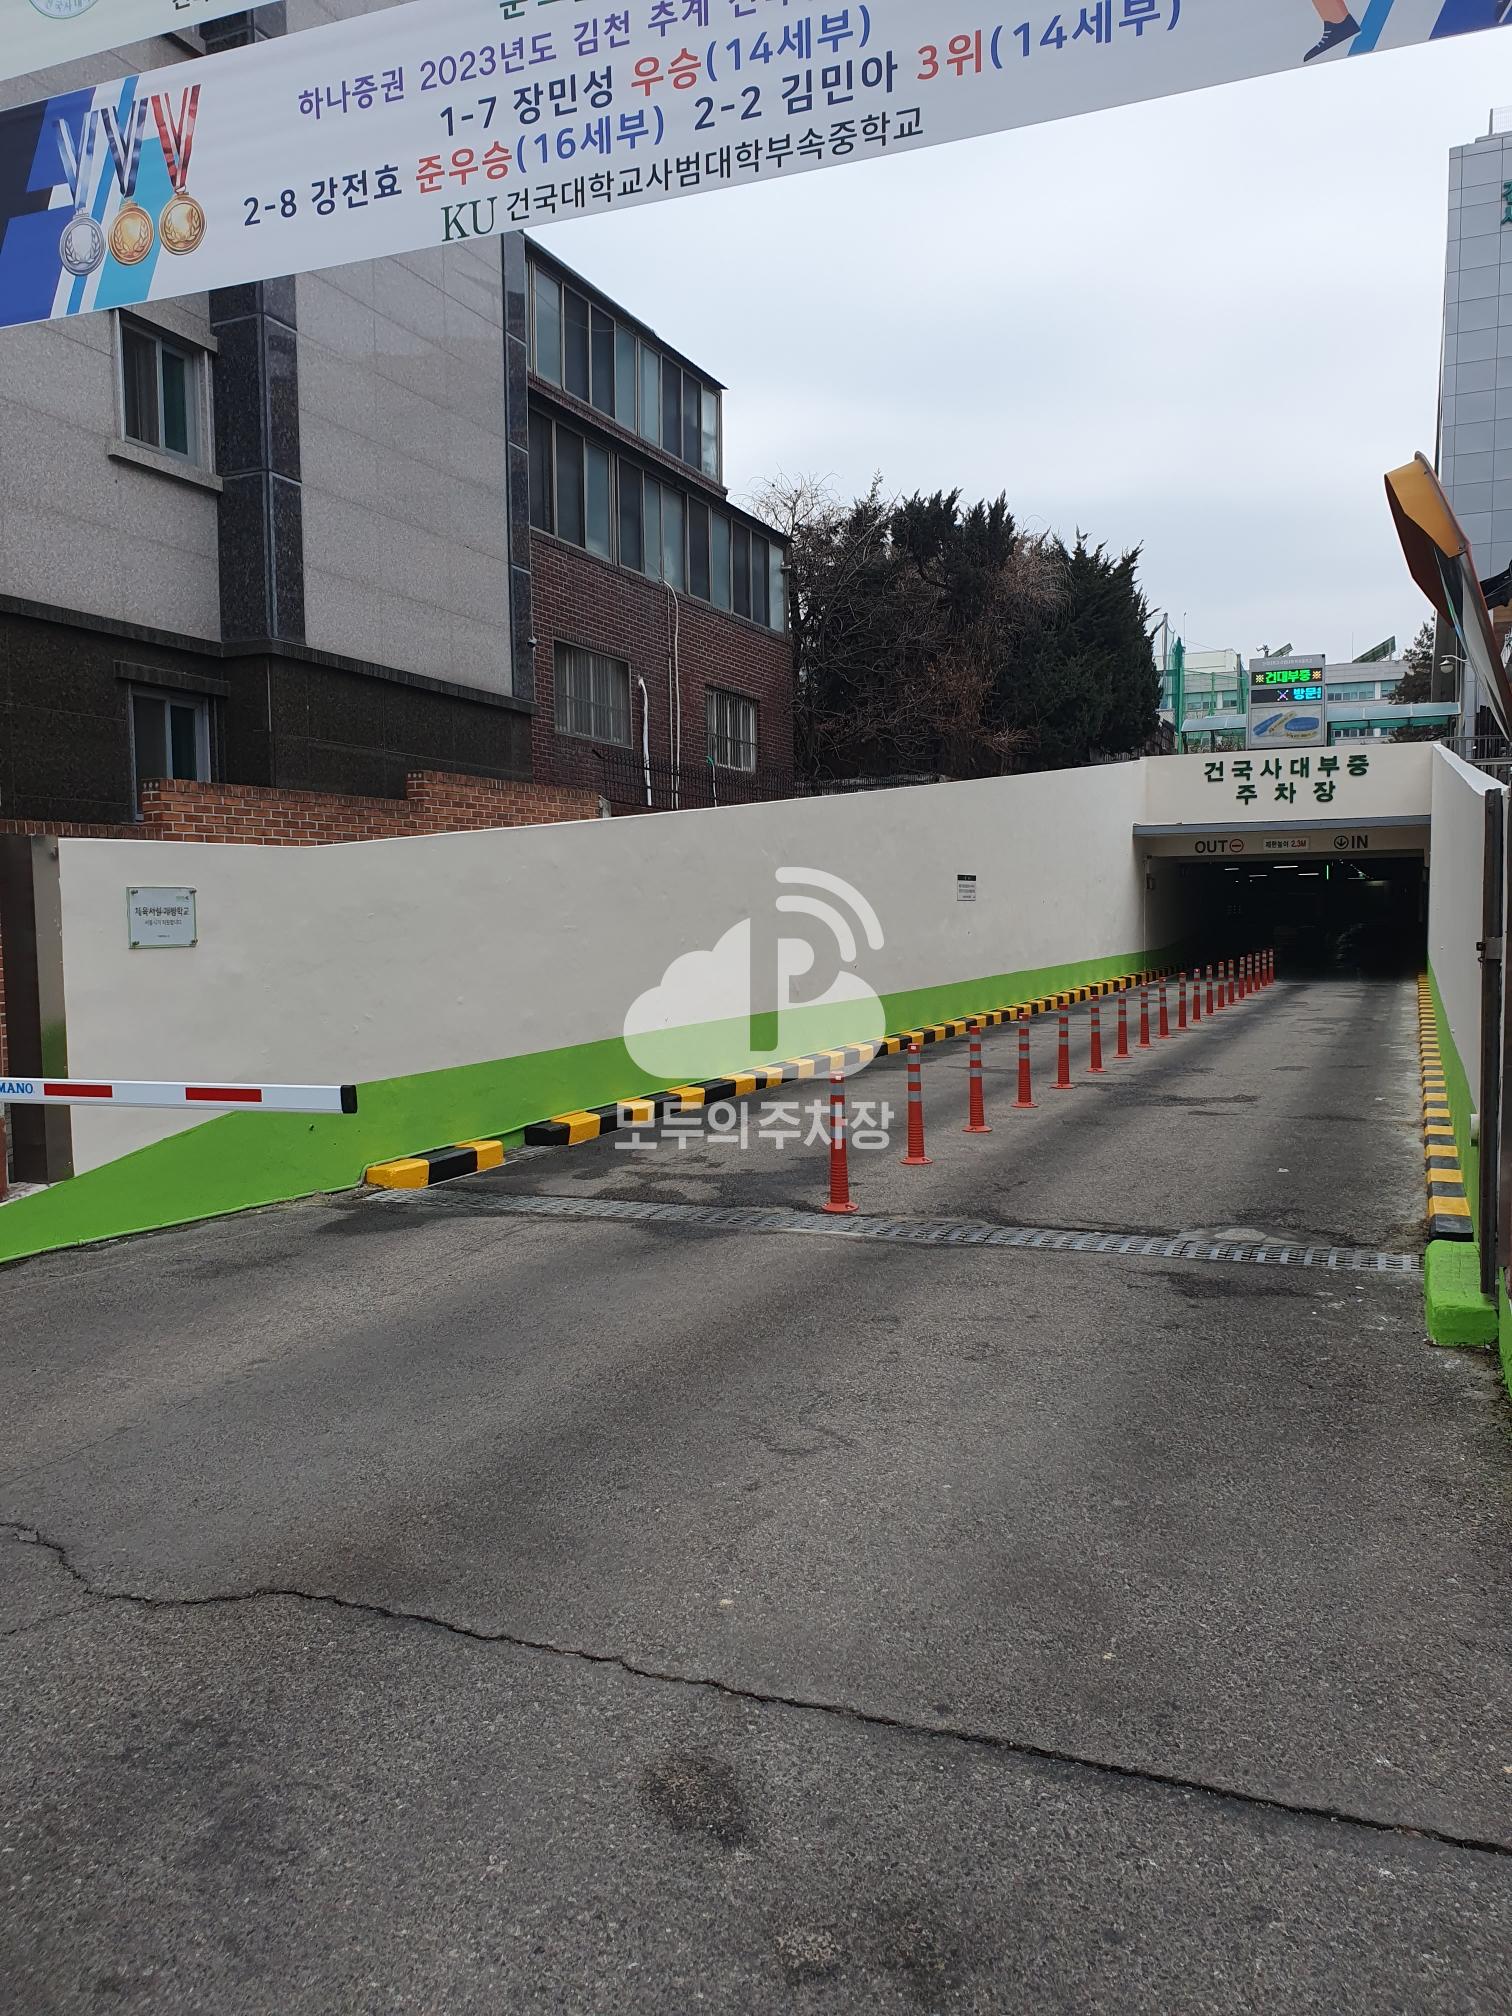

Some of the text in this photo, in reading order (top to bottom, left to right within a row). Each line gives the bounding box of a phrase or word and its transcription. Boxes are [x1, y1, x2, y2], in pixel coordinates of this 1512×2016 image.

[298, 0, 709, 121] 하나증권 2023년도 김천 추계
[440, 5, 872, 136] 1-7 장민성 우승(14세부)
[243, 0, 1182, 226] 2-8 강전효 준우승(16세부) 2-2 김민아 3위(14세부)
[441, 106, 924, 242] KU 건국대학교사범대학부속중학교
[1204, 754, 1370, 783] 건국사대부중
[1236, 781, 1336, 805] 주차장
[1194, 839, 1228, 854] OUT
[1351, 835, 1368, 849] IN
